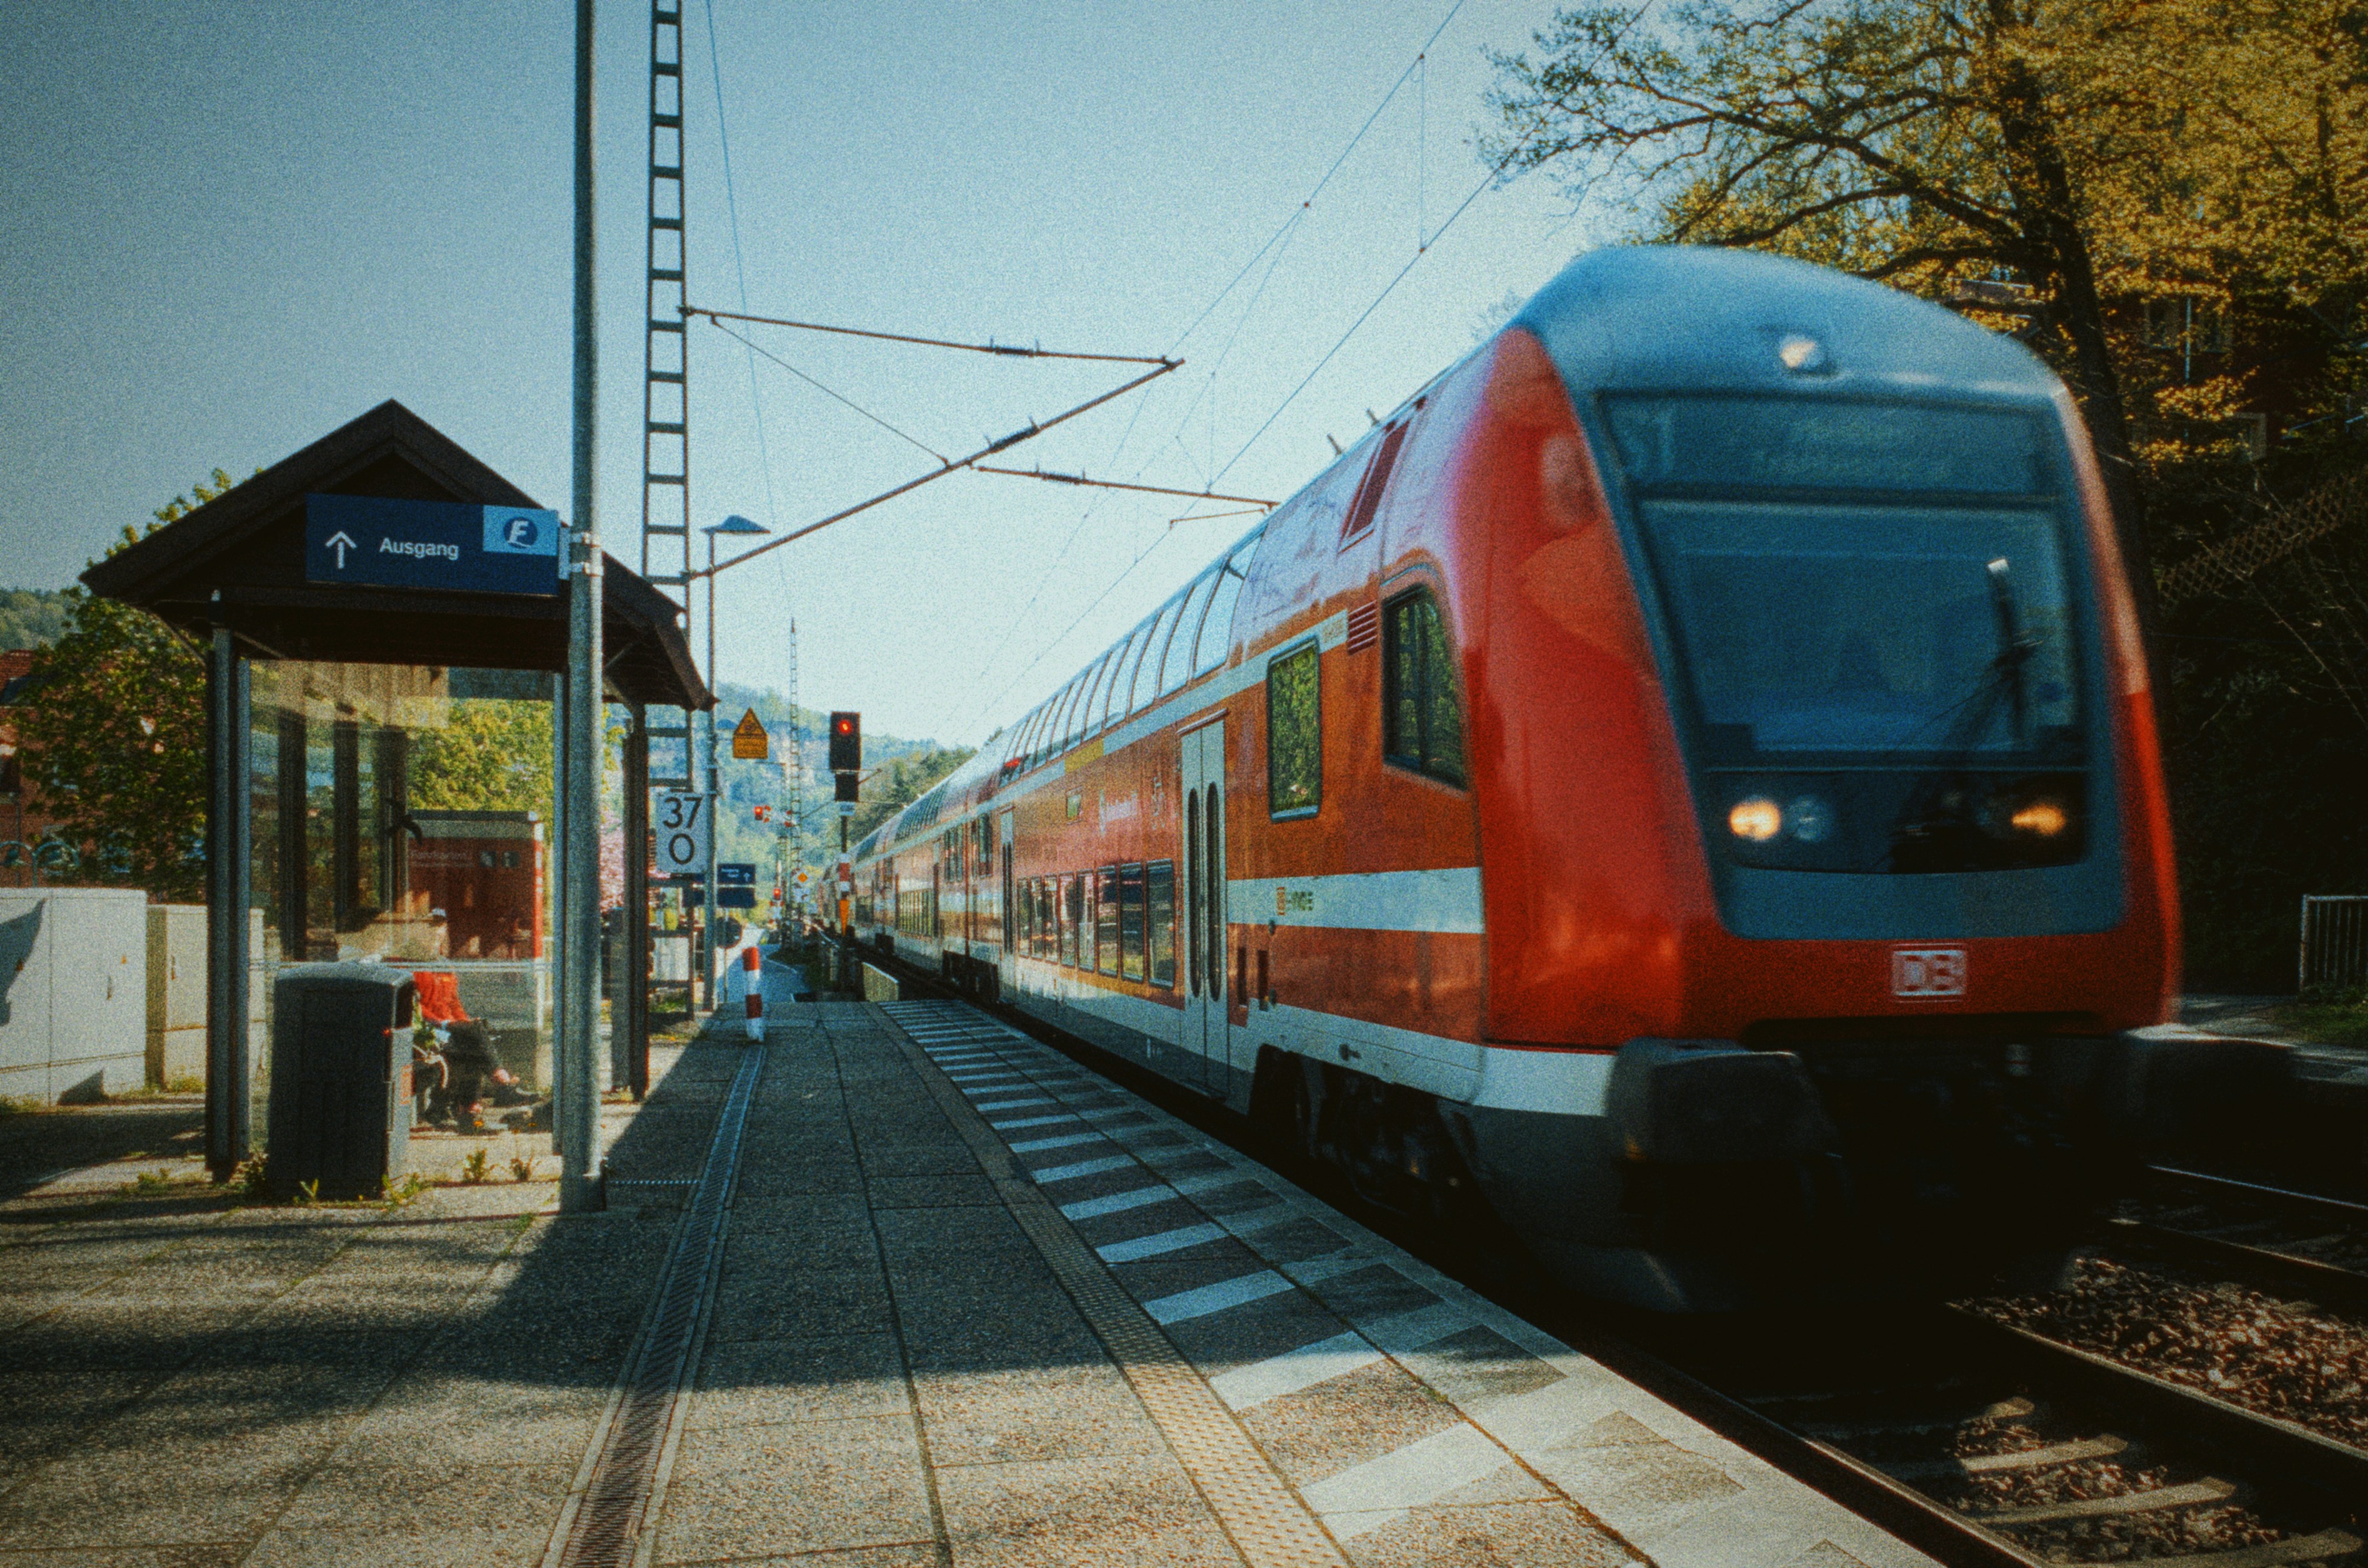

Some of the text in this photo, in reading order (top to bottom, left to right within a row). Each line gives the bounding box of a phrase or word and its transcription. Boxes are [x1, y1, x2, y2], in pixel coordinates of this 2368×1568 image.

[379, 537, 459, 561] Ausgang
[662, 796, 703, 829] 37
[1894, 950, 1965, 996] DB
